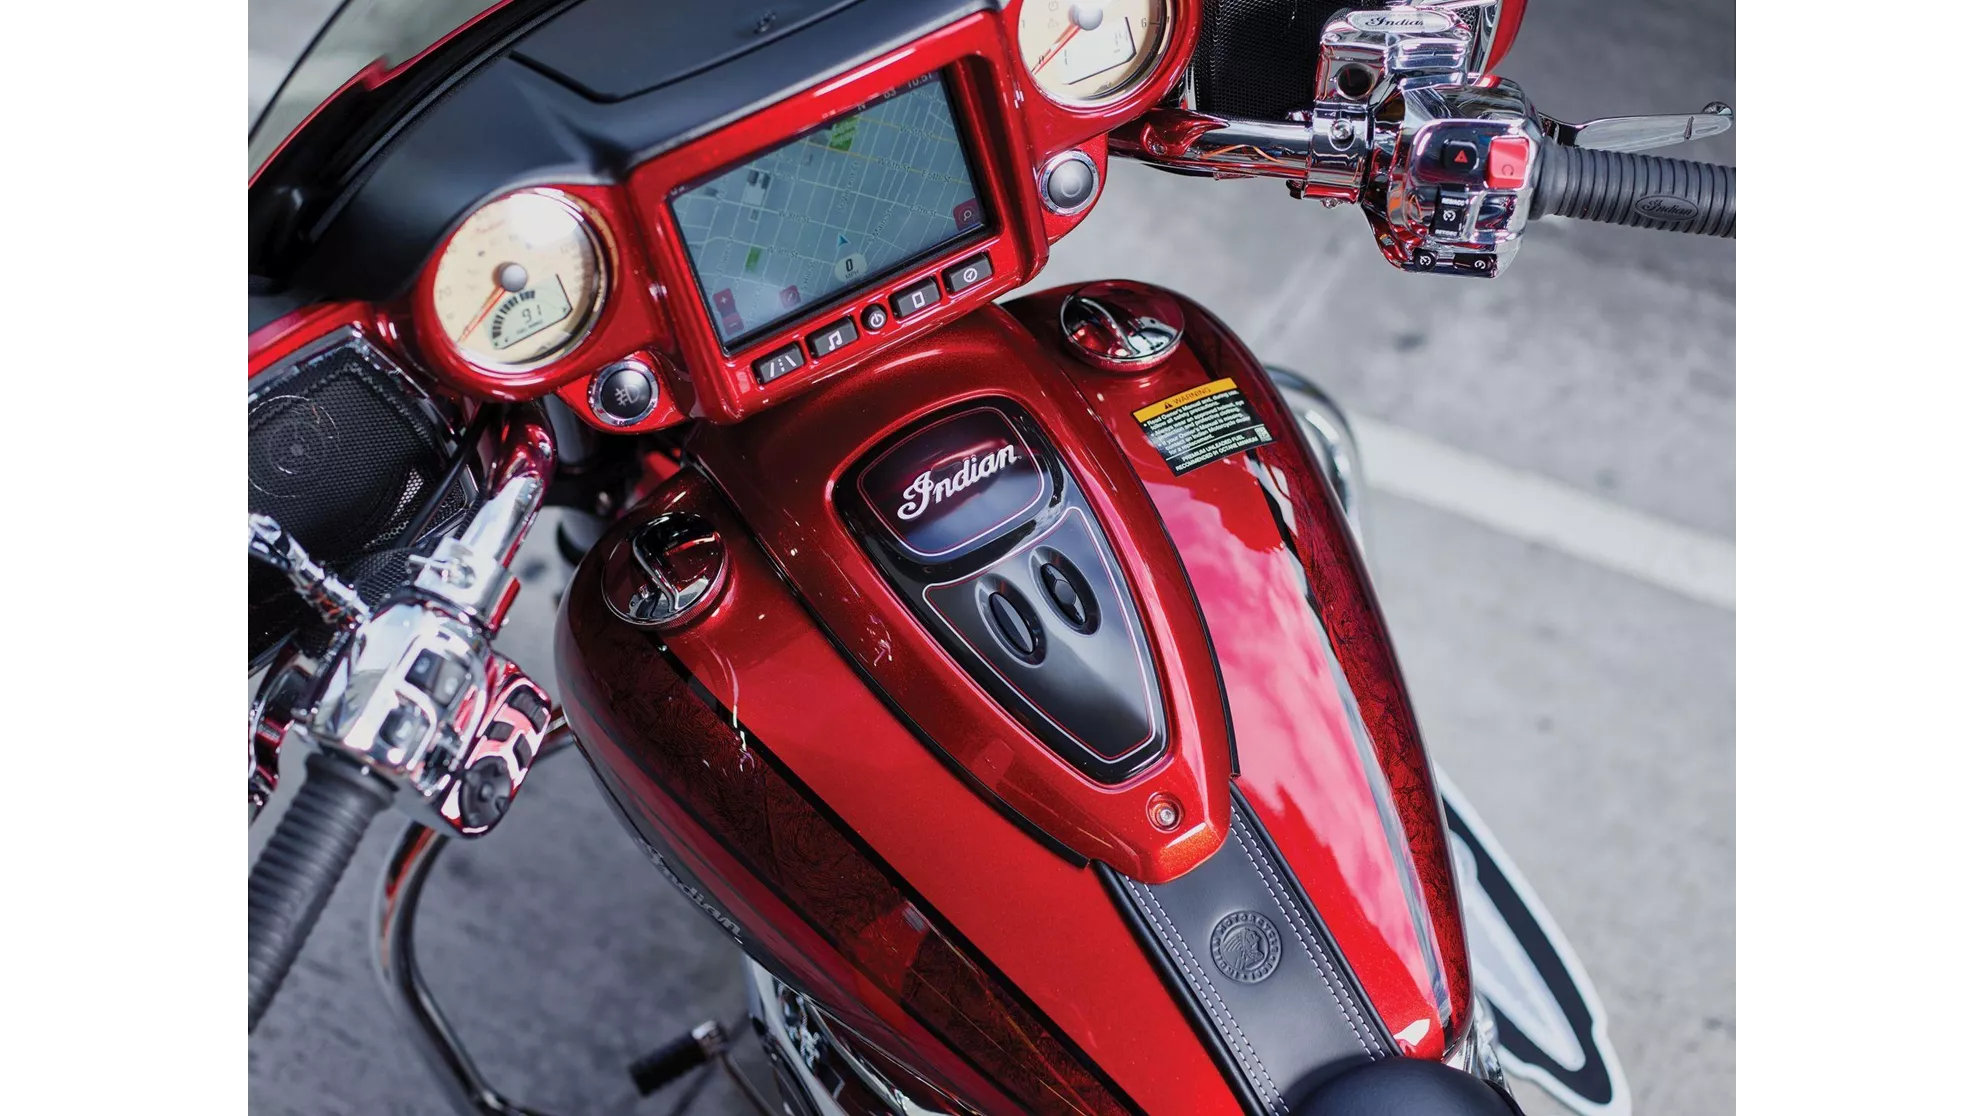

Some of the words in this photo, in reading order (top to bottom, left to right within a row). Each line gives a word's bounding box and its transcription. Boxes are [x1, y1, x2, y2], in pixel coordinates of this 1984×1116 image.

[1641, 199, 1693, 216] Indian
[845, 258, 854, 272] 0
[845, 269, 860, 280] MPH
[1173, 387, 1211, 404] WARNING
[1147, 416, 1161, 426] Read
[1161, 408, 1183, 420] Owner's
[1181, 400, 1201, 411] Manual
[1154, 425, 1174, 436] Always
[1173, 419, 1187, 428] wear
[1193, 407, 1218, 420] approved
[1157, 426, 1185, 441] protection
[1184, 421, 1195, 430] and
[1194, 412, 1220, 426] protective
[1173, 411, 1190, 421] safety
[1165, 439, 1186, 451] contact
[1192, 429, 1209, 440] Indian
[1208, 419, 1236, 433] Motorcycle
[1167, 436, 1179, 445] your
[1178, 427, 1200, 438] Owner's
[1199, 420, 1219, 430] Manual
[1175, 451, 1213, 471] RECOMMENDED
[1218, 442, 1238, 454] OCTANE
[1237, 436, 1259, 446] MINIMUM
[1181, 448, 1207, 461] PREMIUM
[1205, 438, 1233, 453] UNLEADED
[1231, 434, 1245, 443] FUEL
[897, 444, 1019, 520] Indian
[1217, 913, 1280, 953] MOTORCYCLE
[1212, 937, 1239, 980] INDIAN
